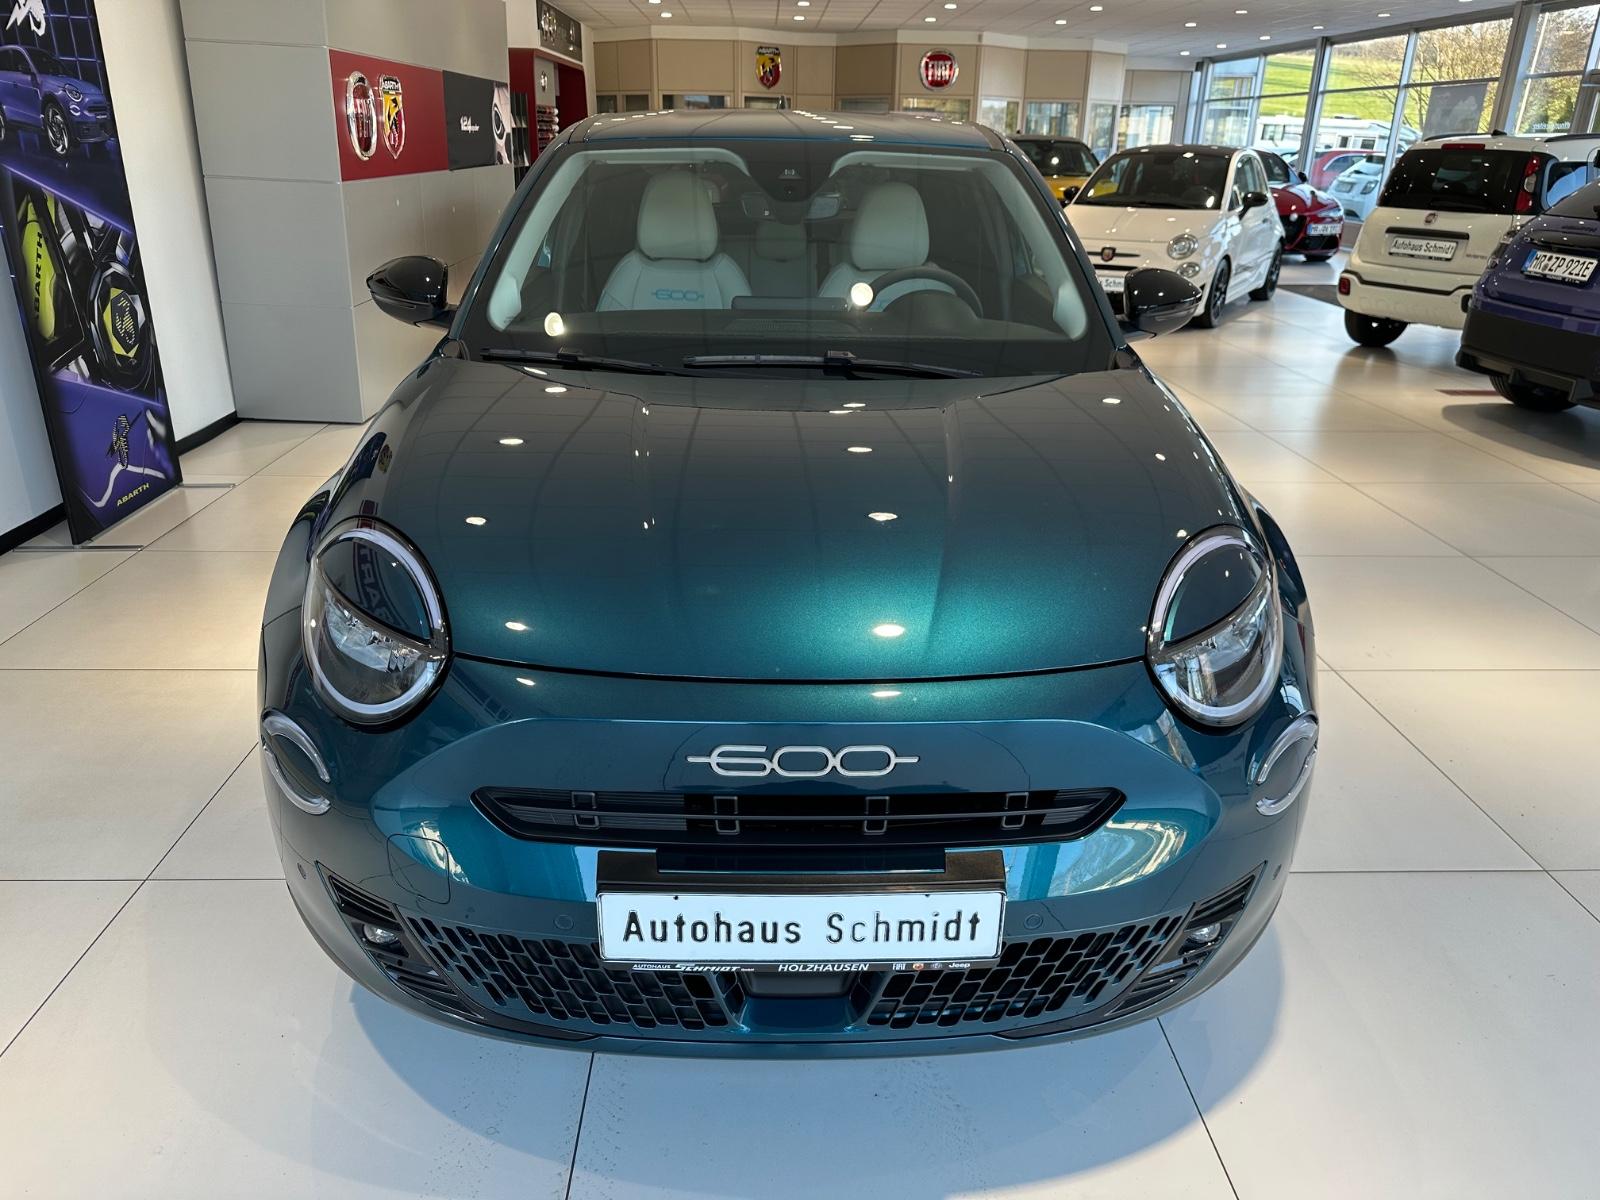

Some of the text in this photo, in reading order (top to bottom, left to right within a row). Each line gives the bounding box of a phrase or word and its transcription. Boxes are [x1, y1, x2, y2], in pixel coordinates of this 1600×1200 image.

[928, 60, 952, 80] FIAT
[1392, 239, 1456, 255] Autohaus Schmidt
[1548, 256, 1566, 272] ZP
[1563, 258, 1594, 278] 921E
[655, 289, 699, 301] 600
[117, 483, 150, 507] ABARTH
[709, 744, 897, 777] 600
[622, 910, 981, 945] Autohaus Schmidt
[778, 963, 870, 973] HOLZHAUSEN
